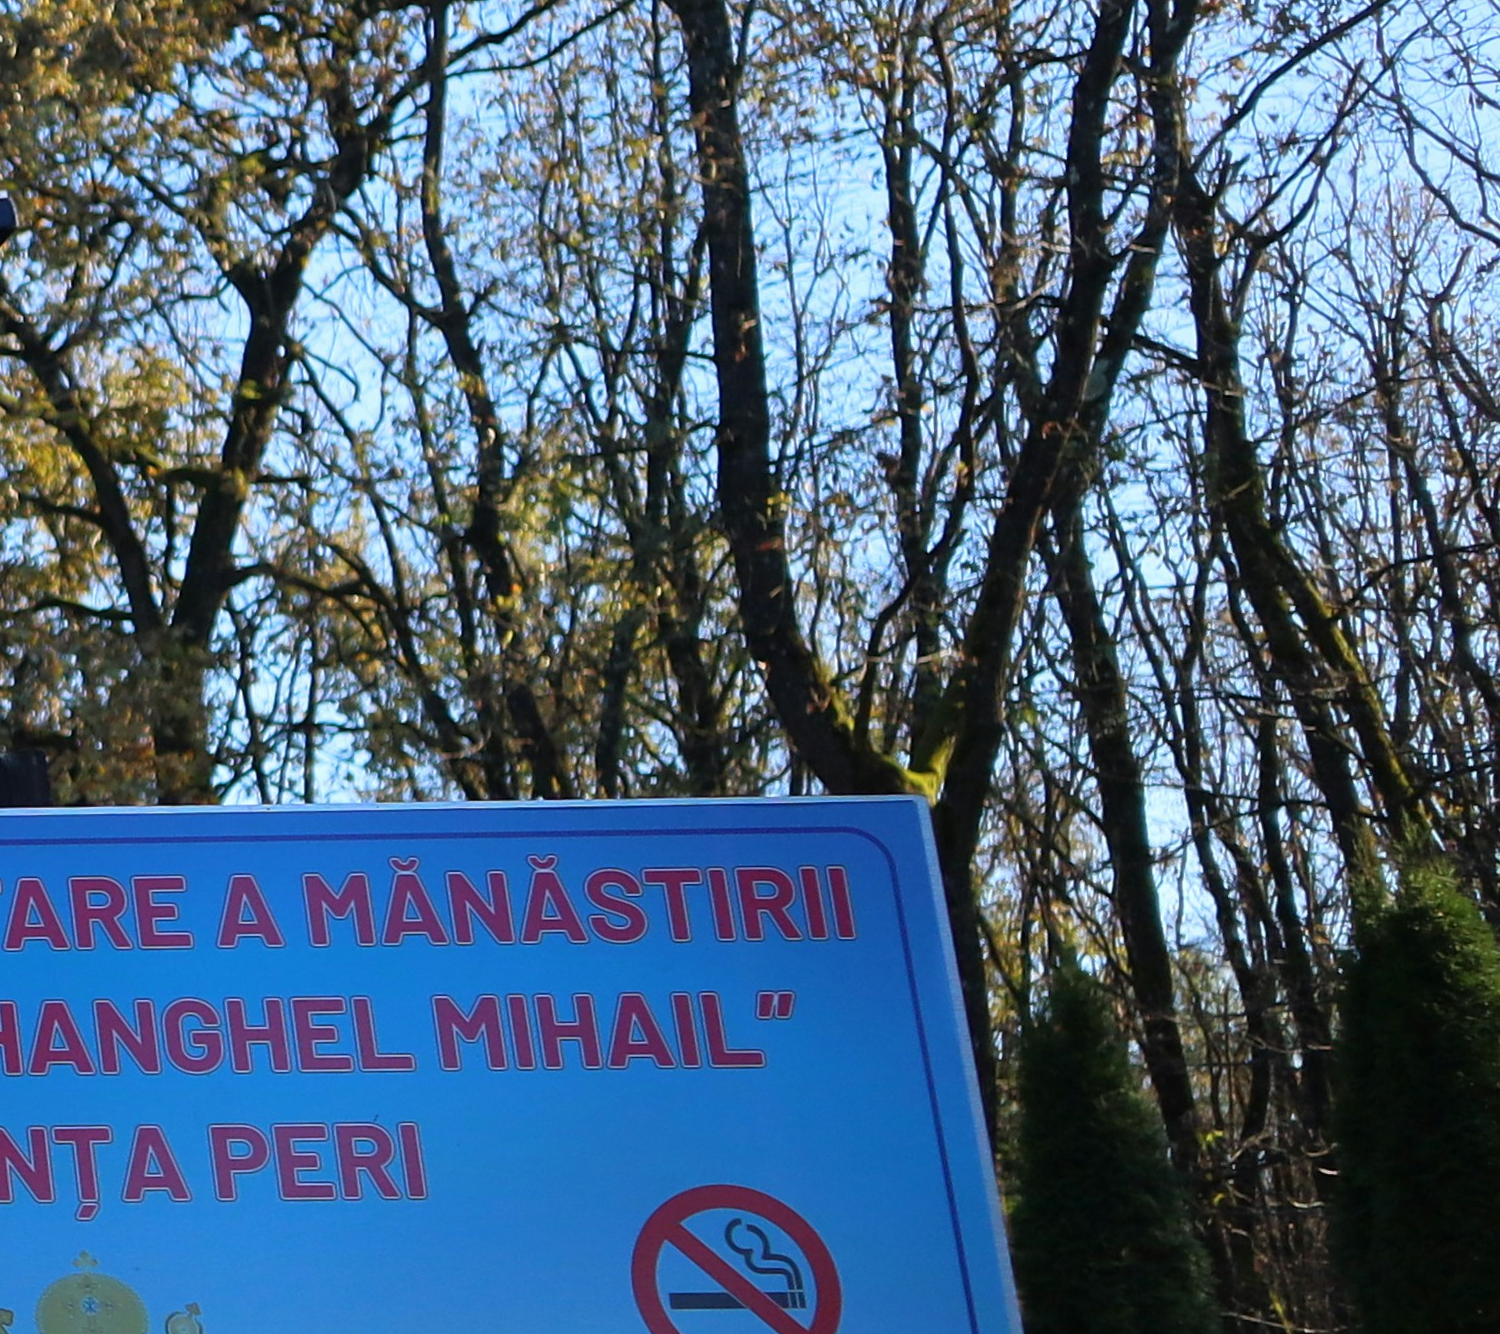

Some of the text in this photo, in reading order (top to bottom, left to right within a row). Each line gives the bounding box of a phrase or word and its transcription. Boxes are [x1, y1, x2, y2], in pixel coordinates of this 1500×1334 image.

[217, 875, 285, 948] A
[303, 855, 857, 946] MĂNĂSTIRII
[209, 1123, 427, 1201] PERI
